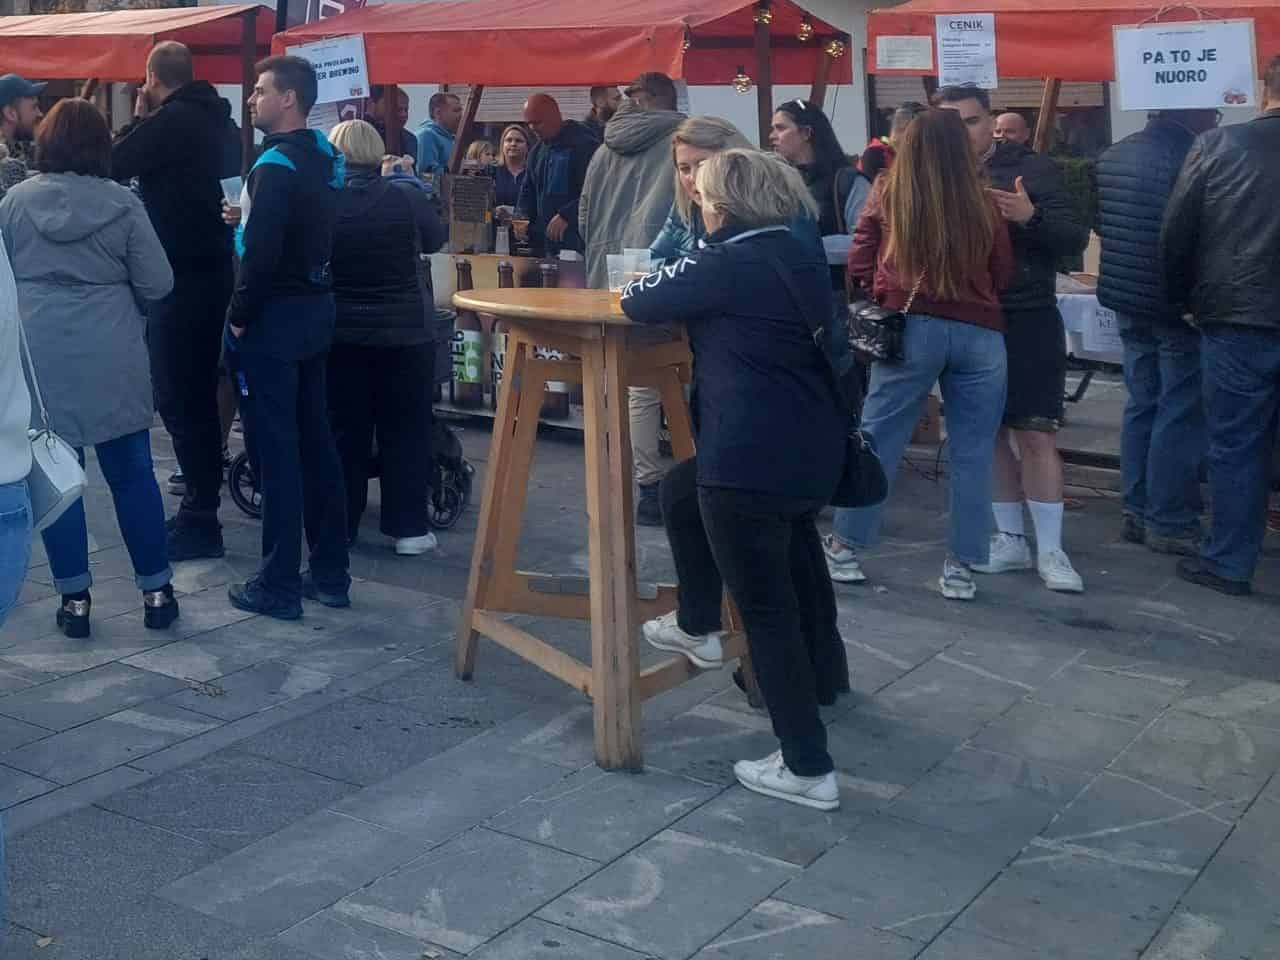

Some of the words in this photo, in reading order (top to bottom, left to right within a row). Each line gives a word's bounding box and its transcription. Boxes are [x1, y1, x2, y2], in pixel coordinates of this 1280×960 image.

[949, 21, 984, 30] CENIK
[1143, 51, 1166, 65] PA
[1170, 50, 1191, 63] TO
[1197, 48, 1217, 62] JE
[1155, 69, 1207, 84] NUORO
